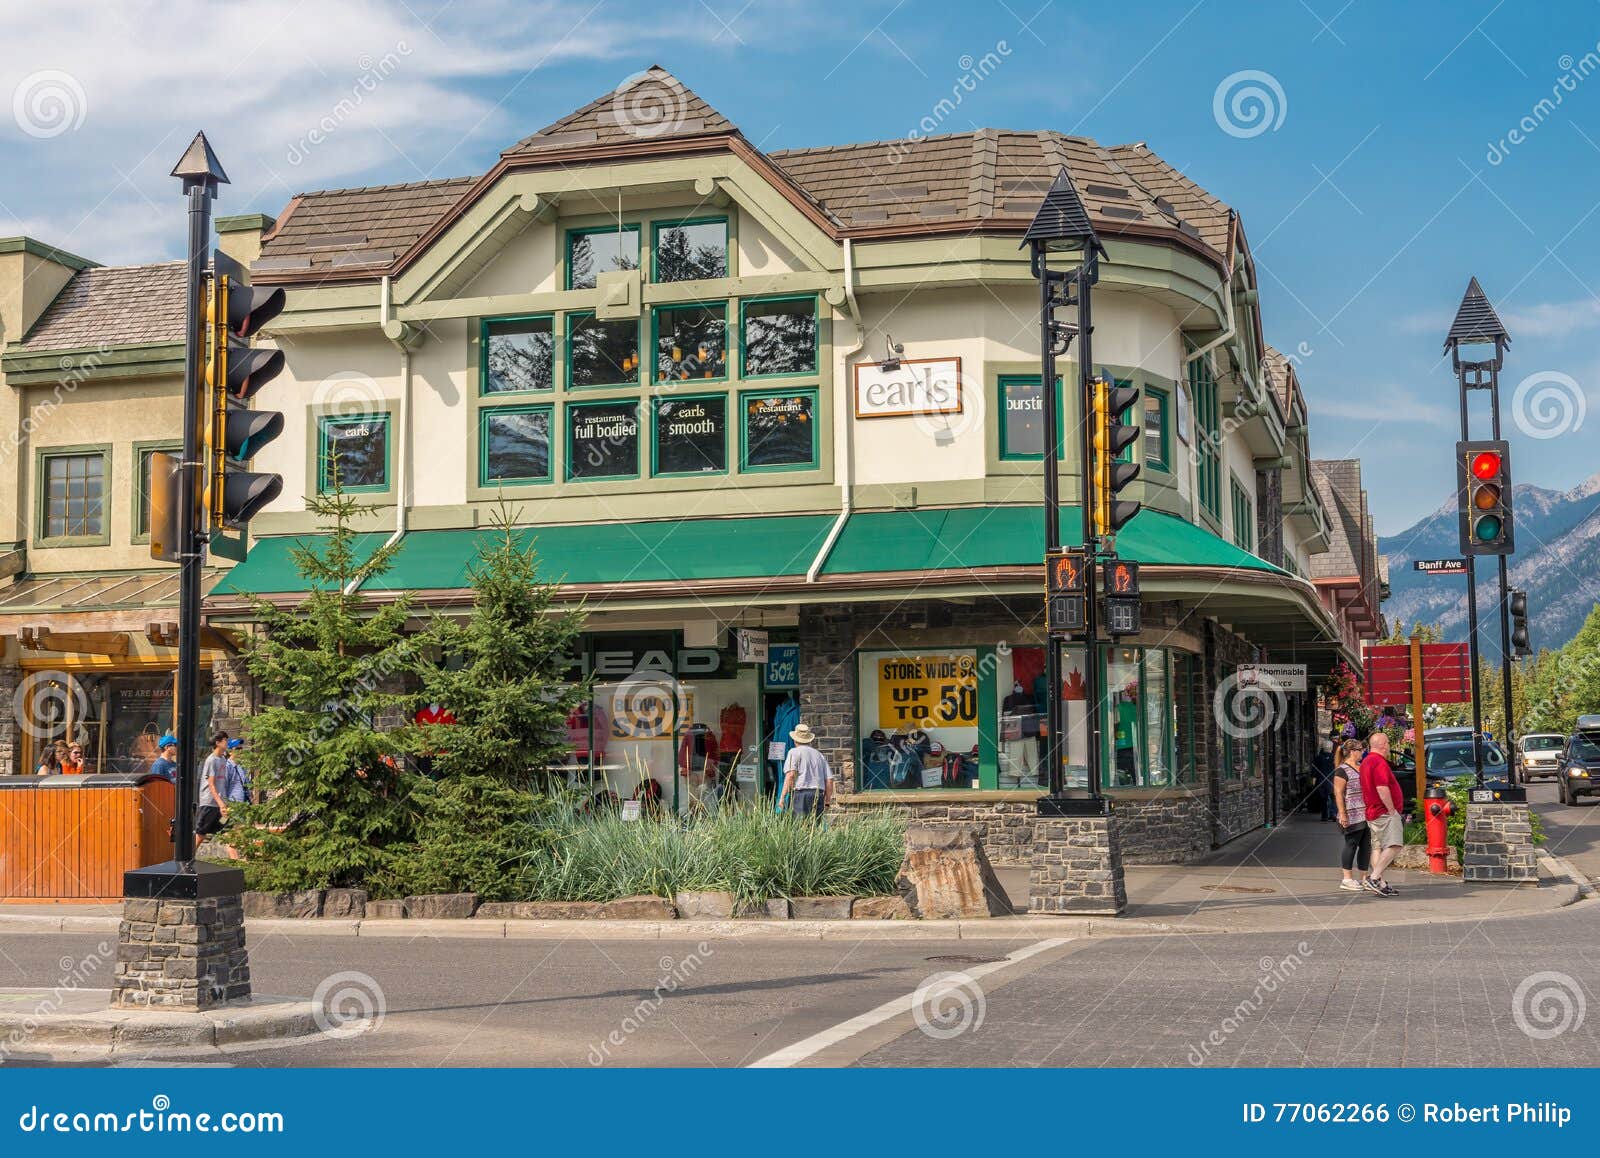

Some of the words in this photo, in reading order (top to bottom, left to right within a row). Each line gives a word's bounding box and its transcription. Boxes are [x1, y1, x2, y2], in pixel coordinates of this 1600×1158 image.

[866, 367, 950, 406] earls
[679, 404, 705, 418] earls
[759, 402, 802, 413] restaurant
[585, 414, 626, 424] restaurant
[345, 424, 369, 437] earls
[575, 423, 593, 439] full
[597, 422, 637, 438] bodied
[669, 419, 715, 435] smooth
[1418, 560, 1443, 570] Banff
[1444, 560, 1462, 569] Ave
[555, 650, 721, 674] HEAD
[769, 661, 795, 682] 50%
[883, 662, 922, 680] STORE
[926, 662, 956, 680] WIDE
[120, 689, 133, 697] WE
[135, 689, 151, 697] ARE
[892, 687, 929, 702] UP
[894, 705, 929, 719] TO
[612, 716, 690, 738] SALE
